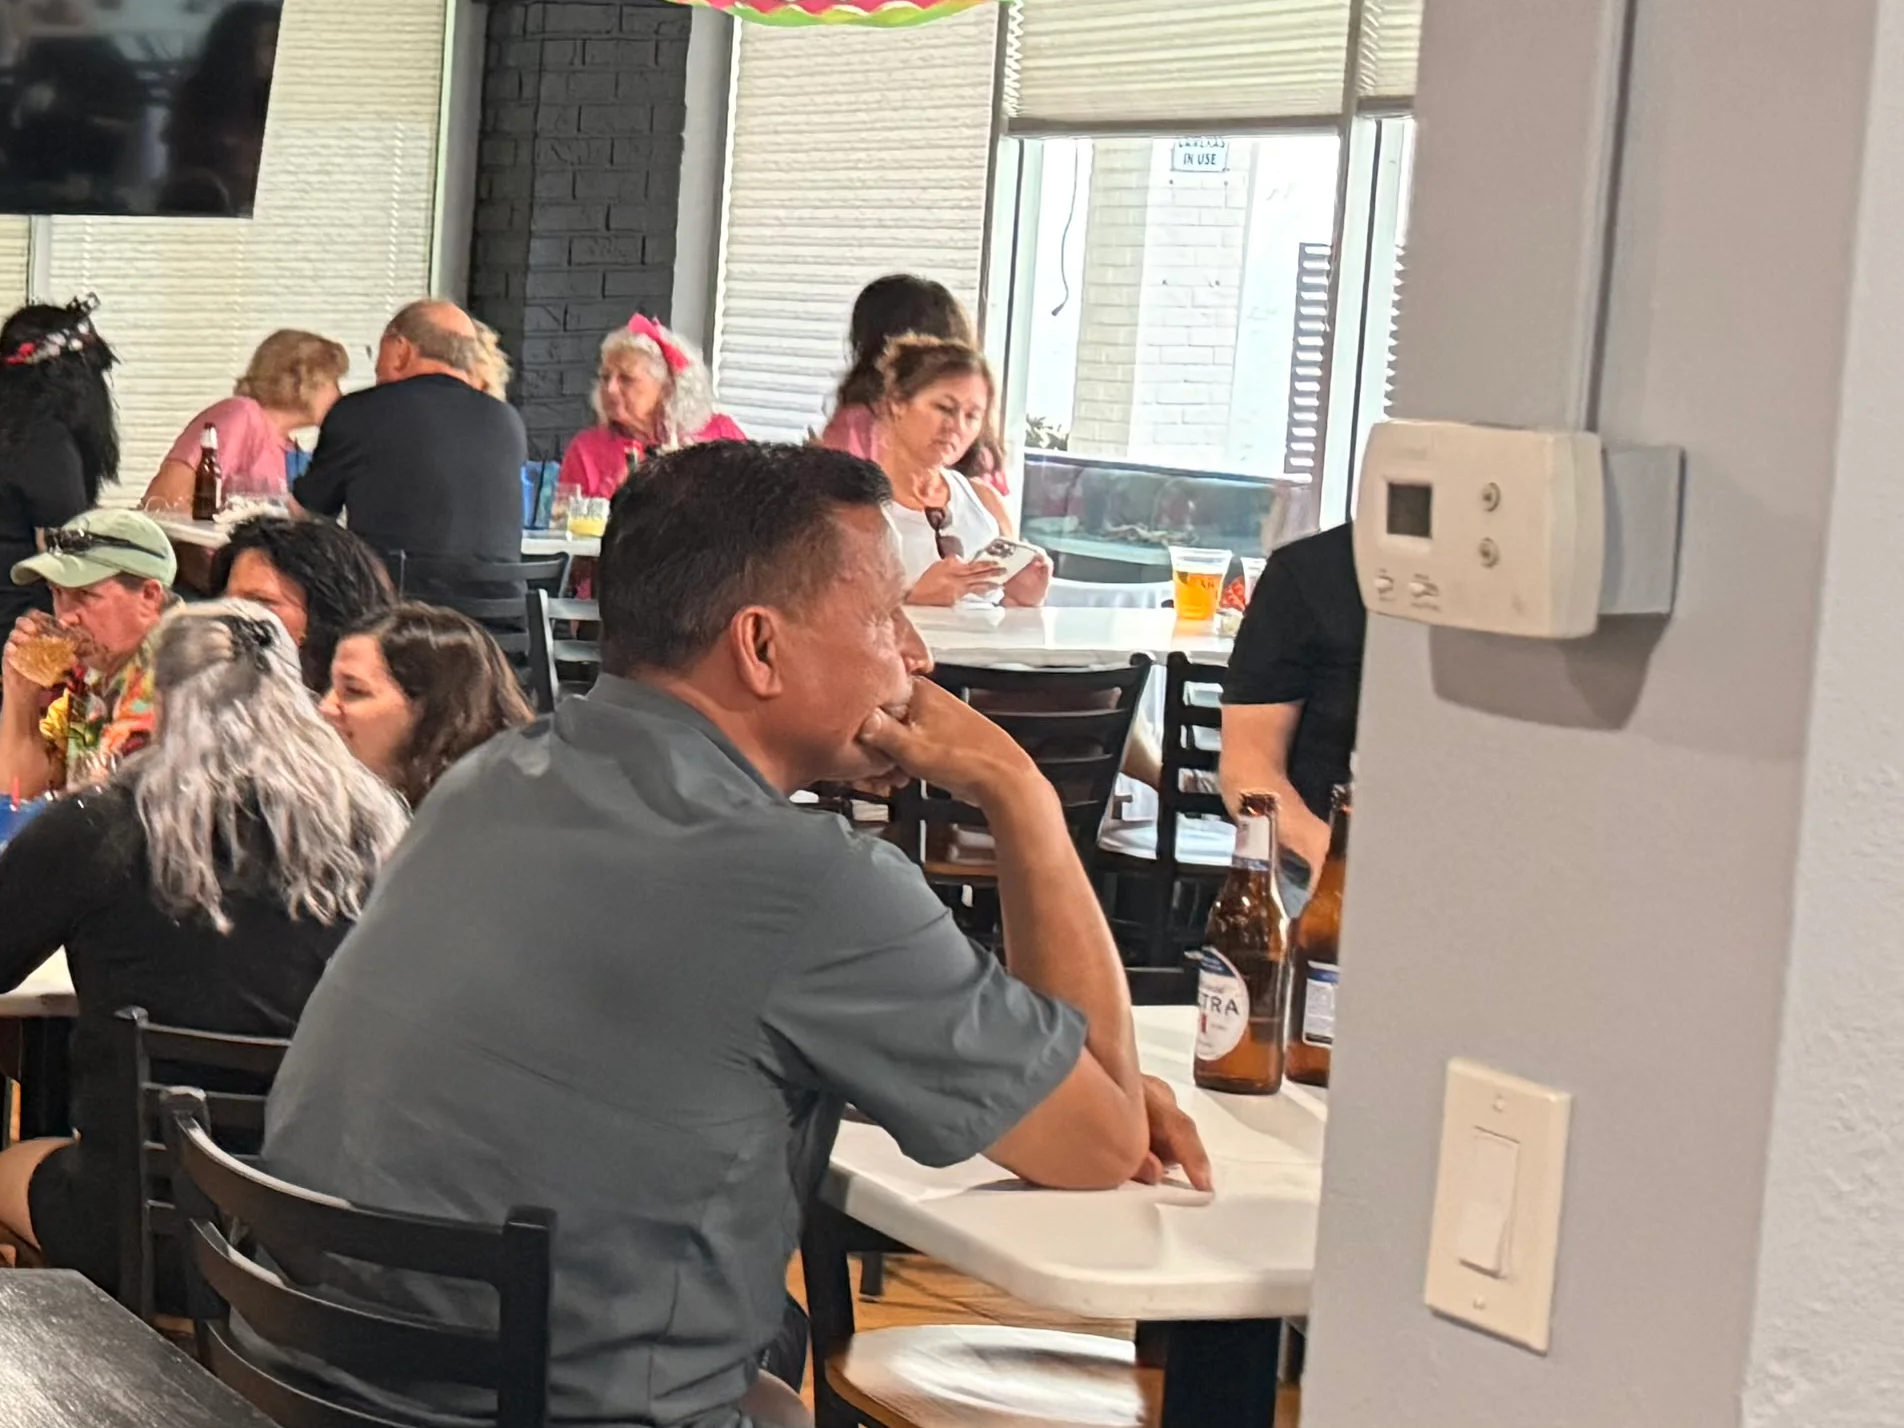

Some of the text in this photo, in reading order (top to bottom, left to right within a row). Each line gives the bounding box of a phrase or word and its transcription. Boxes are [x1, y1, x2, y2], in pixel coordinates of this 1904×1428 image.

[1183, 153, 1217, 165] IN USE
[1200, 992, 1240, 1017] TRA
